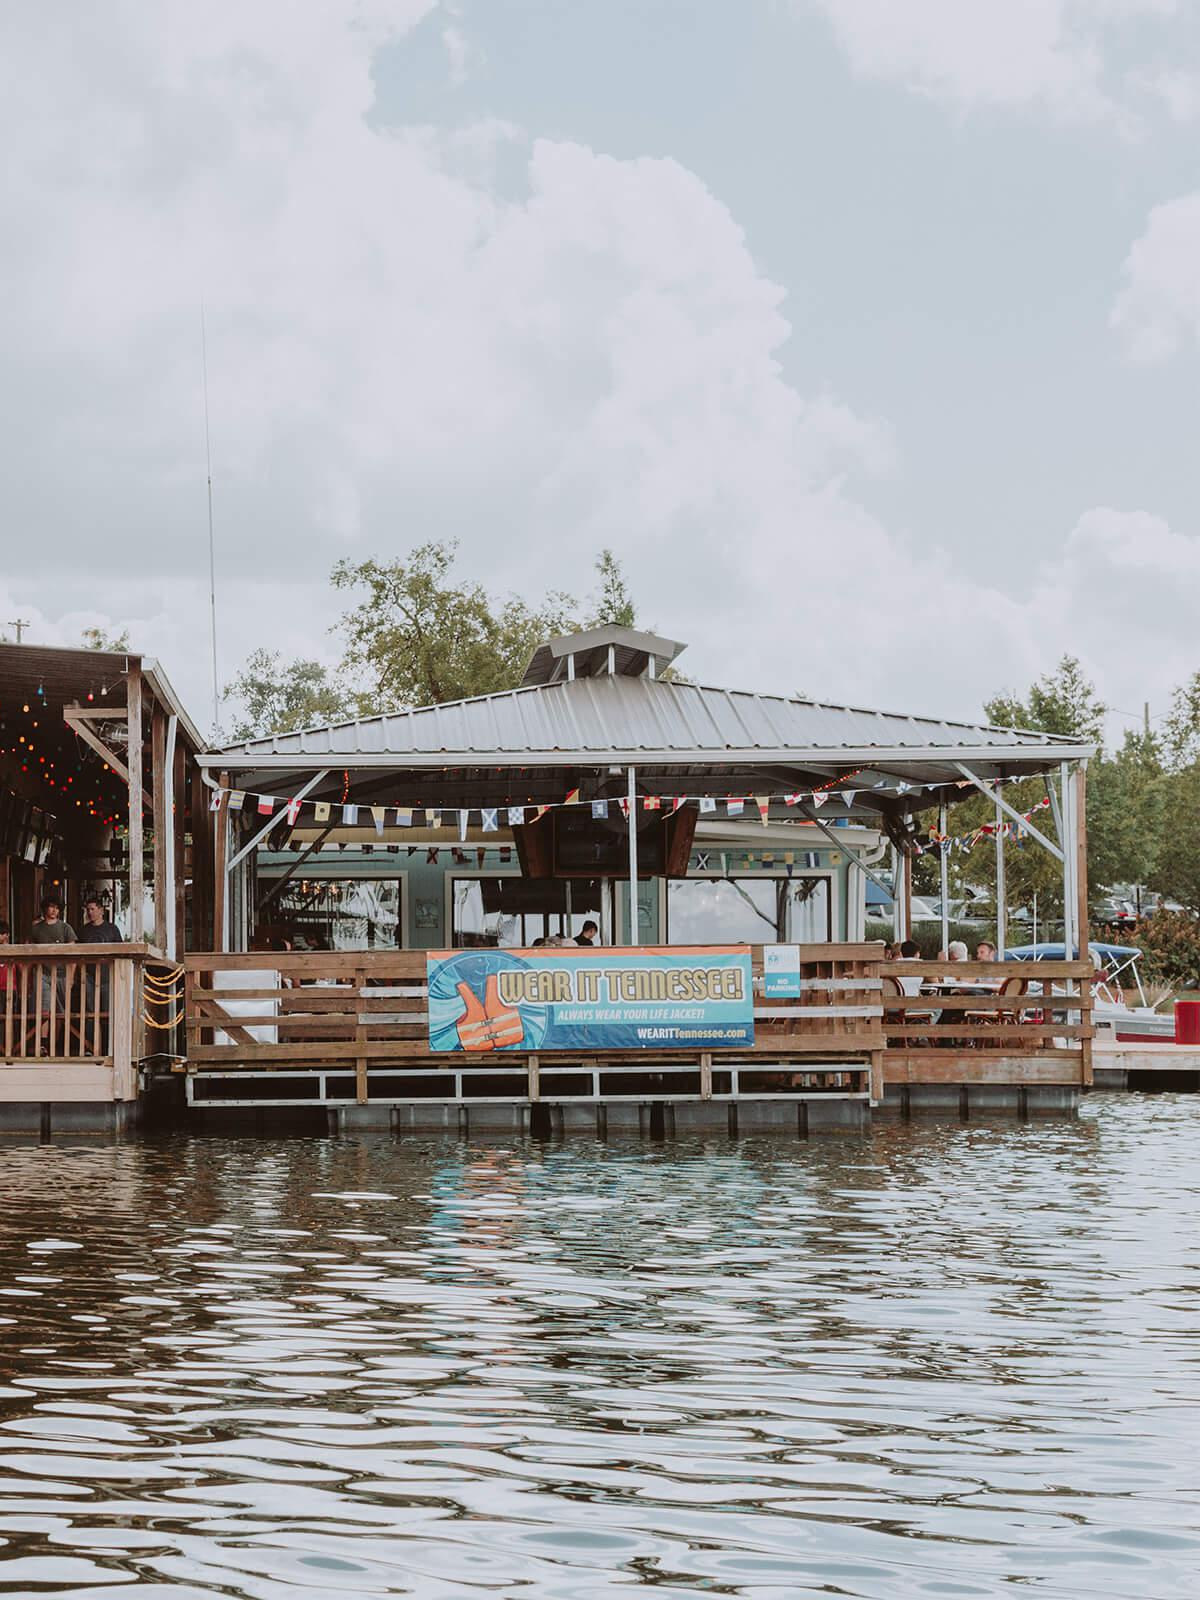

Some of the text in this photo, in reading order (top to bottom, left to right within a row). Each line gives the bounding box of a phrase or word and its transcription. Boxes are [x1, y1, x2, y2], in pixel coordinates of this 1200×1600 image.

[499, 969, 743, 1002] WEAR IT TENNESSEE!
[766, 984, 800, 992] PARKING
[558, 1008, 706, 1021] ALWAYS WEAR YOUR LIFE JACKET!
